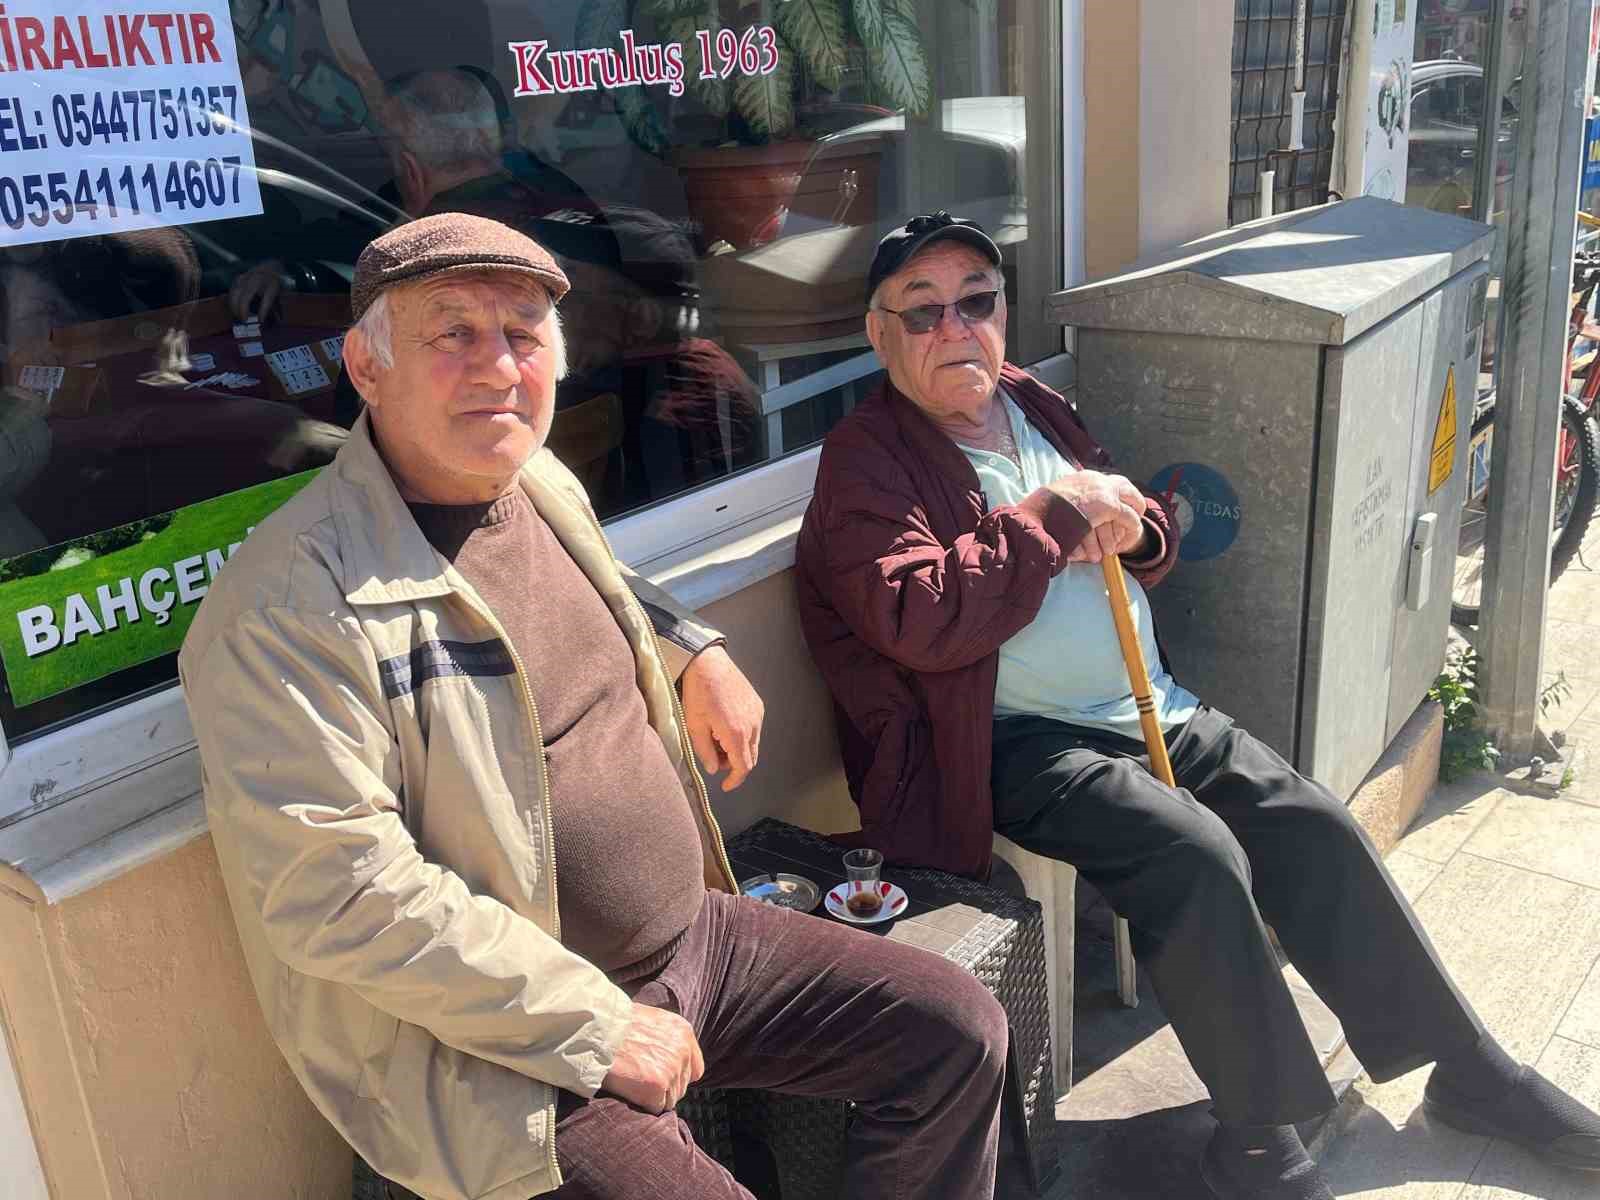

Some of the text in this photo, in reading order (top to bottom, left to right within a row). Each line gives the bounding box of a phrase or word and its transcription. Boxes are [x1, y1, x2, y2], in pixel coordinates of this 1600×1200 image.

[0, 4, 222, 72] İRALIKTIR
[508, 26, 779, 97] Kuruluş 1963
[52, 85, 237, 148] 05447751357
[0, 156, 241, 229] 05541114607
[17, 527, 255, 657] BAHÇE
